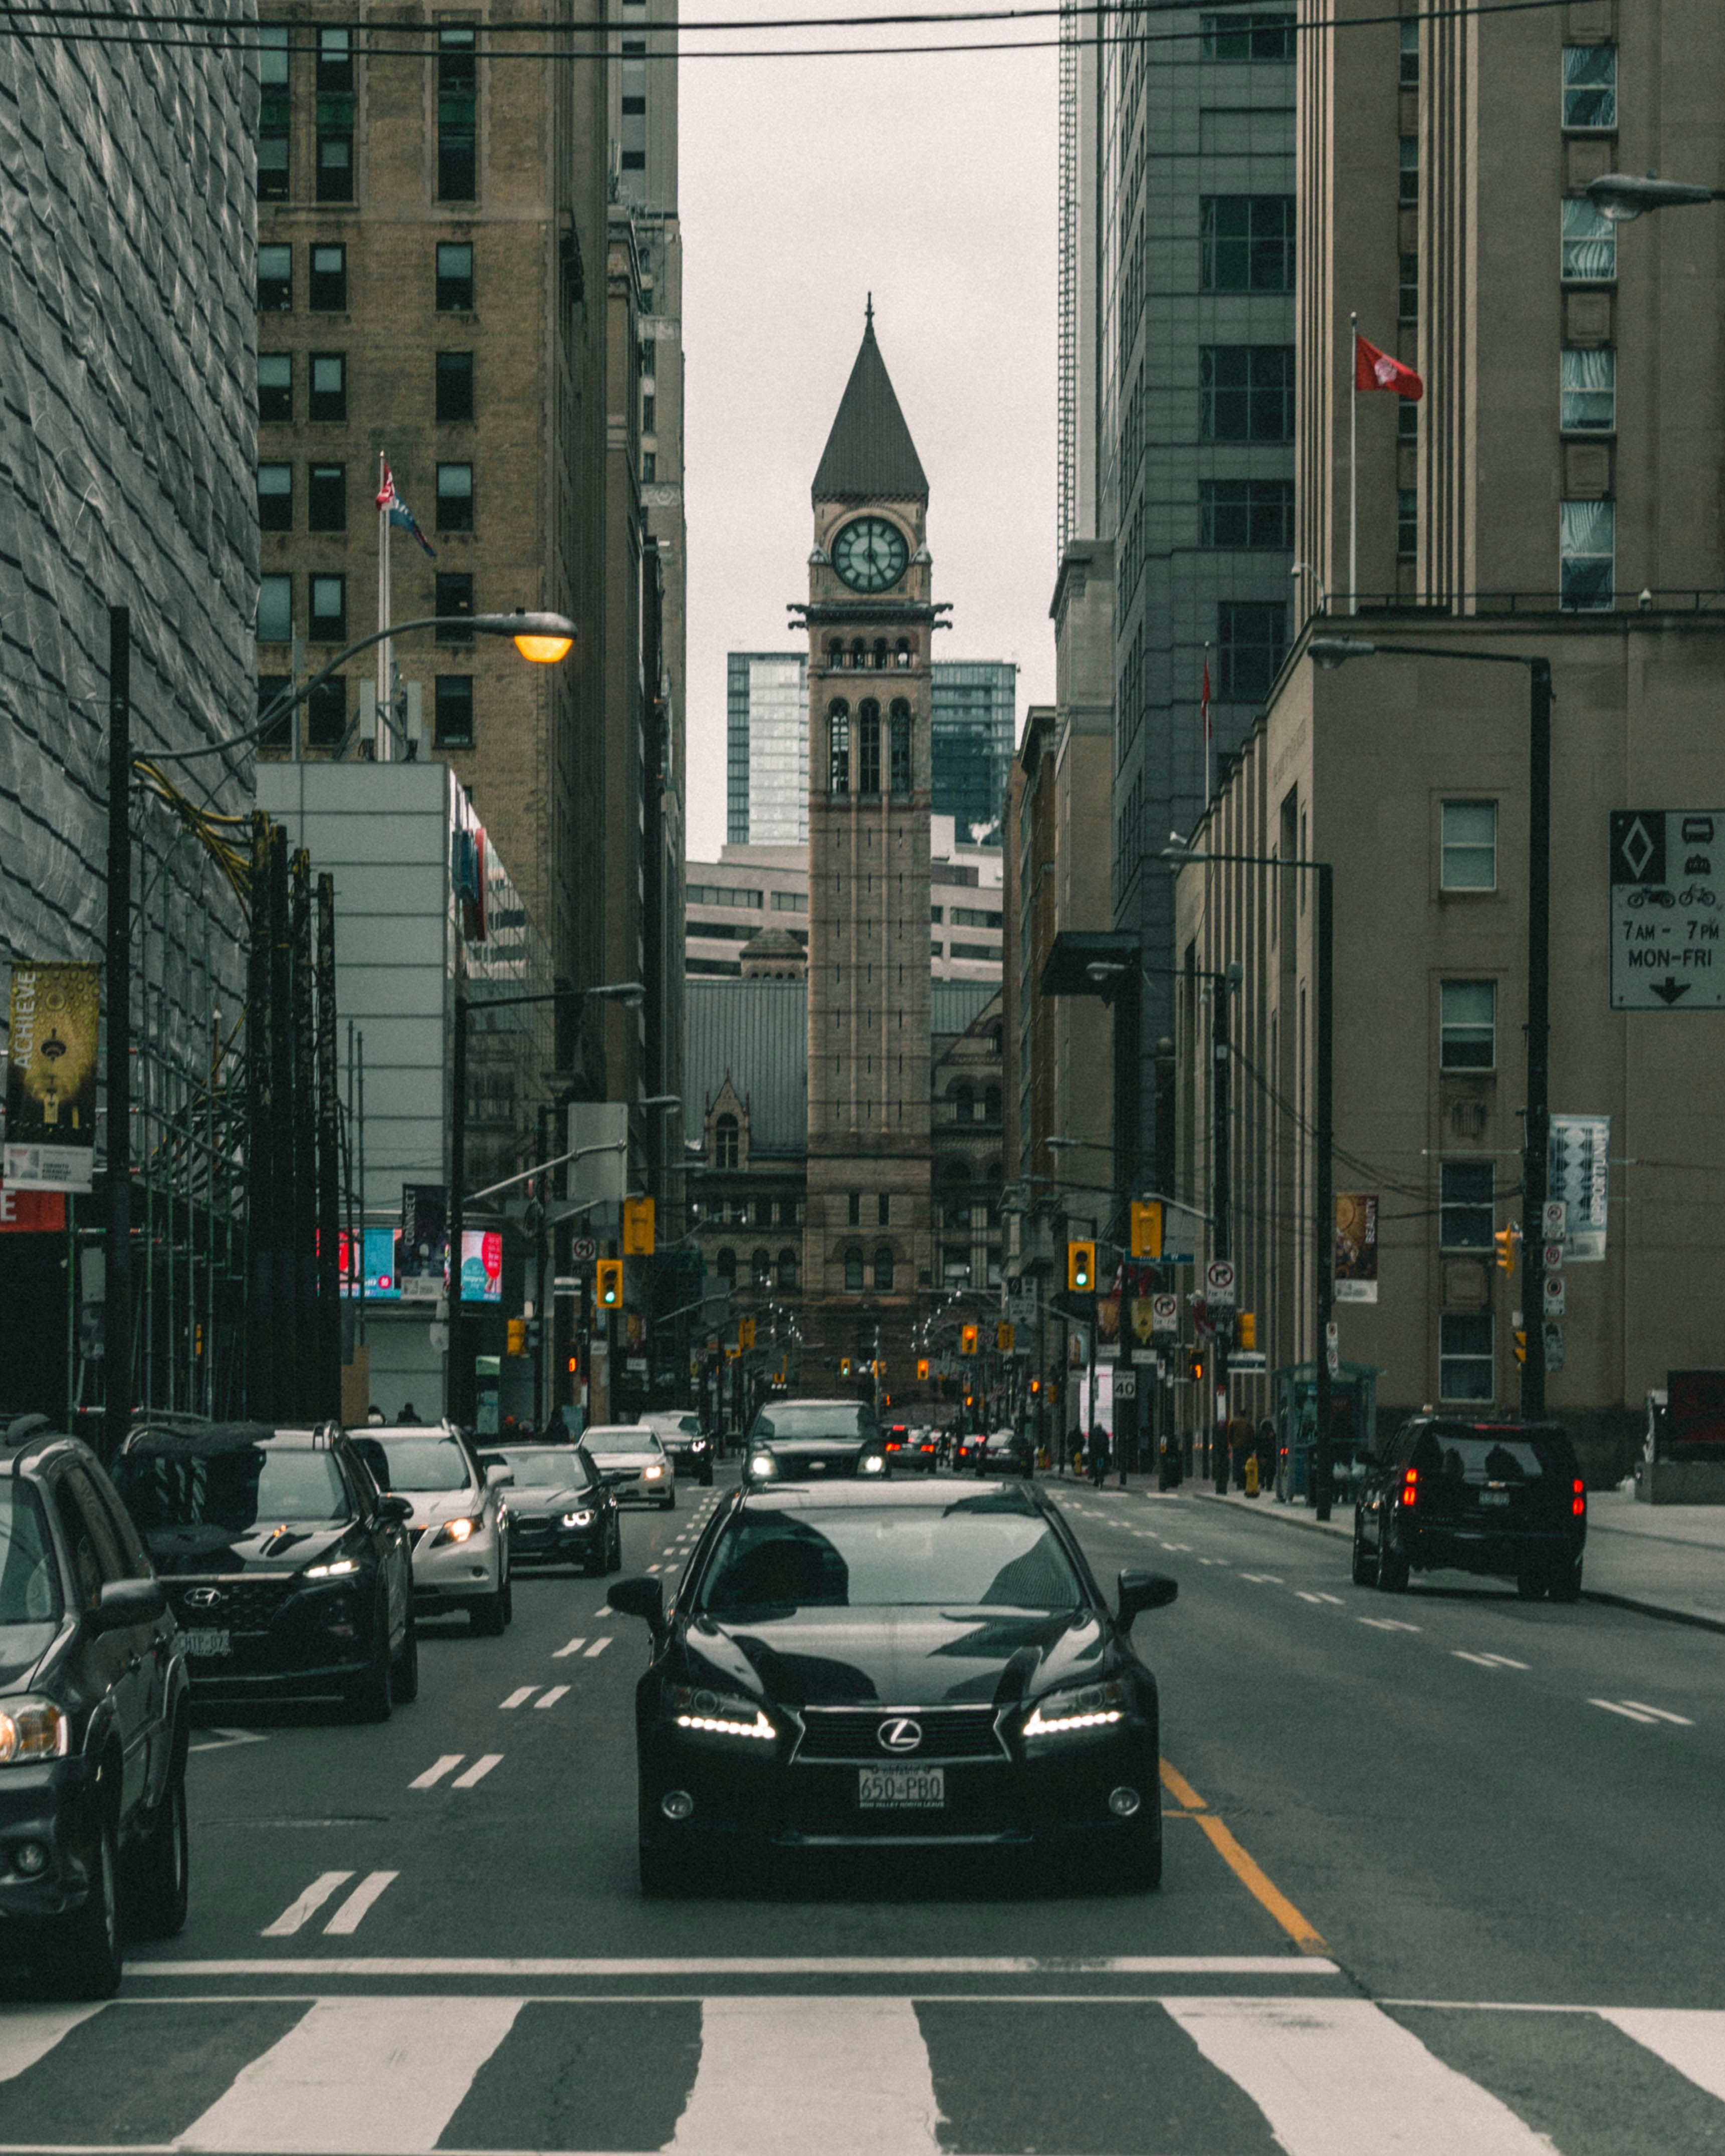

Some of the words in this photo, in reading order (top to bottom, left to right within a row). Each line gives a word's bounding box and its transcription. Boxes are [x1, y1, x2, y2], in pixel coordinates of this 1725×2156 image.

[1629, 949, 1711, 967] MON-FRI
[14, 971, 36, 1069] ACHIEVE
[1591, 1123, 1607, 1226] OPPORTUNITY
[404, 1189, 415, 1246] CONNECT
[1365, 1198, 1375, 1243] BEAUTY
[1115, 1382, 1134, 1396] 40
